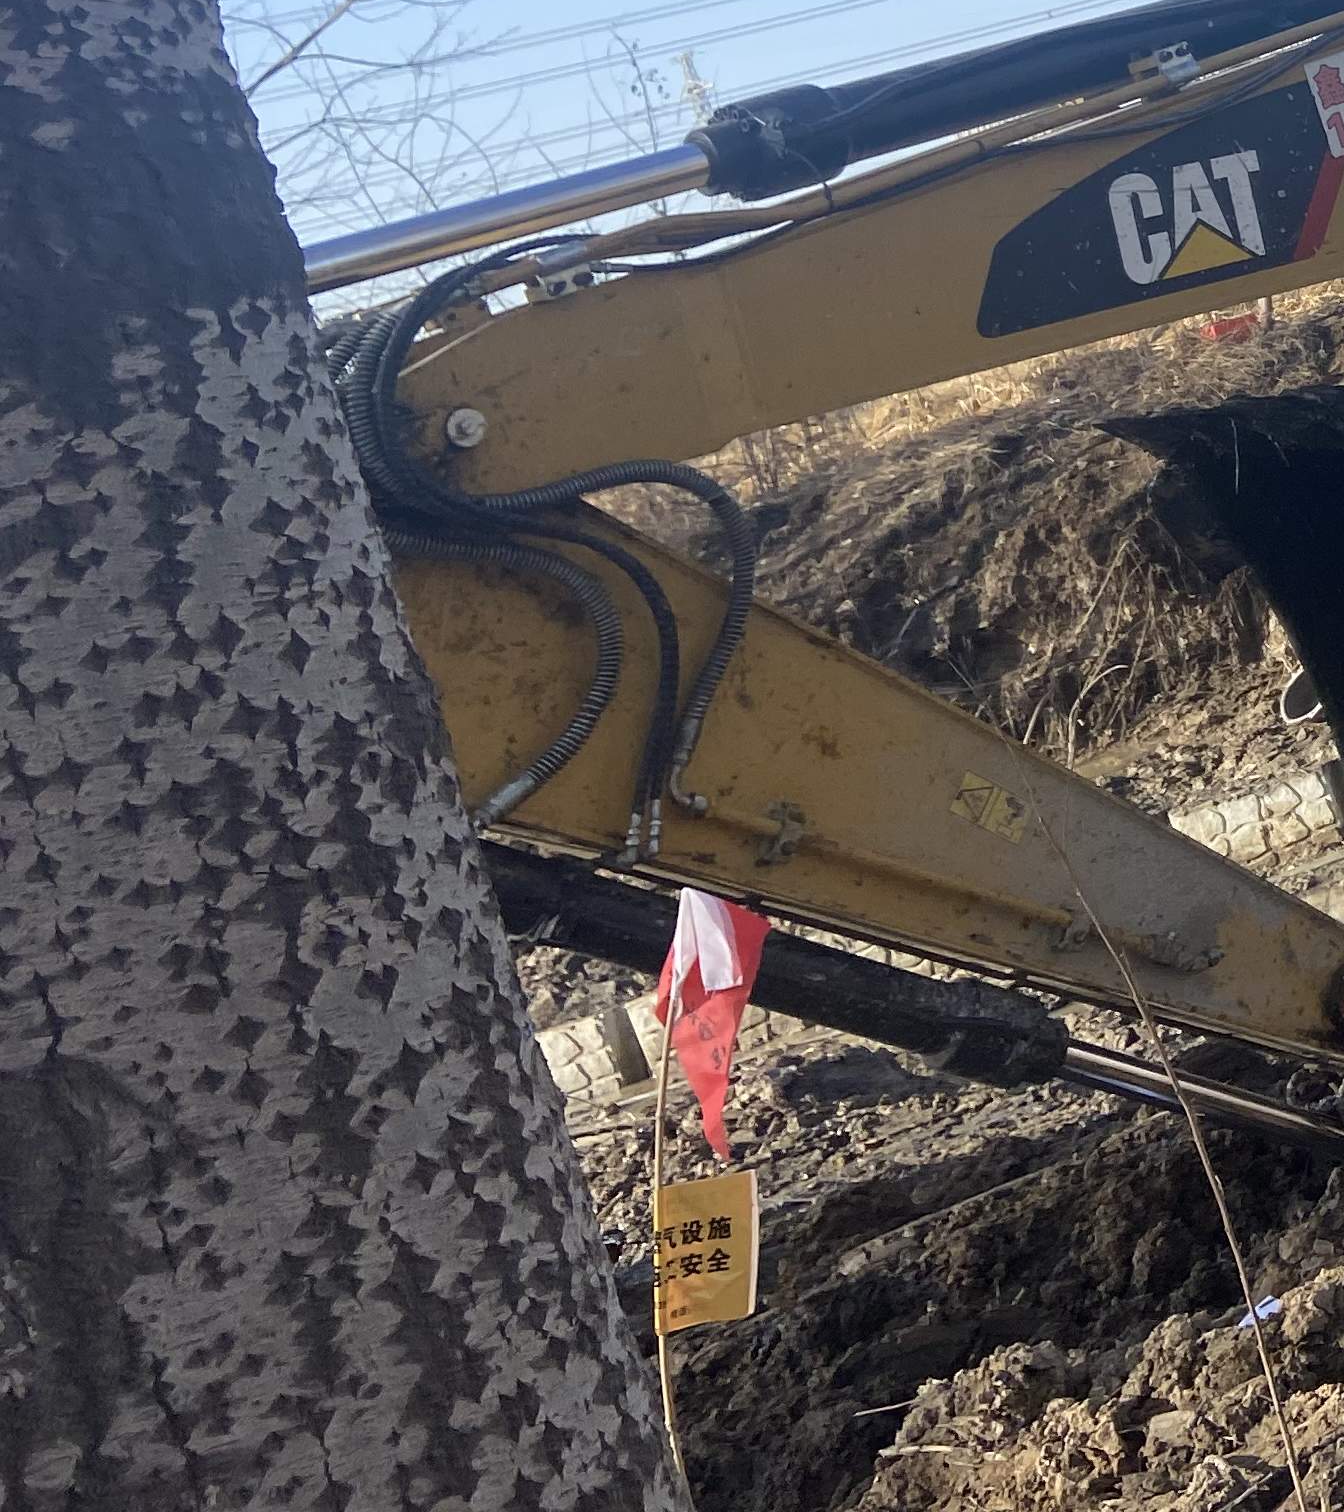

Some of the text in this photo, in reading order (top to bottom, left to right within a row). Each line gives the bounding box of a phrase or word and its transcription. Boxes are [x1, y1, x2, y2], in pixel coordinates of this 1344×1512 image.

[1108, 150, 1266, 285] CAT
[654, 1215, 732, 1254] 气设施
